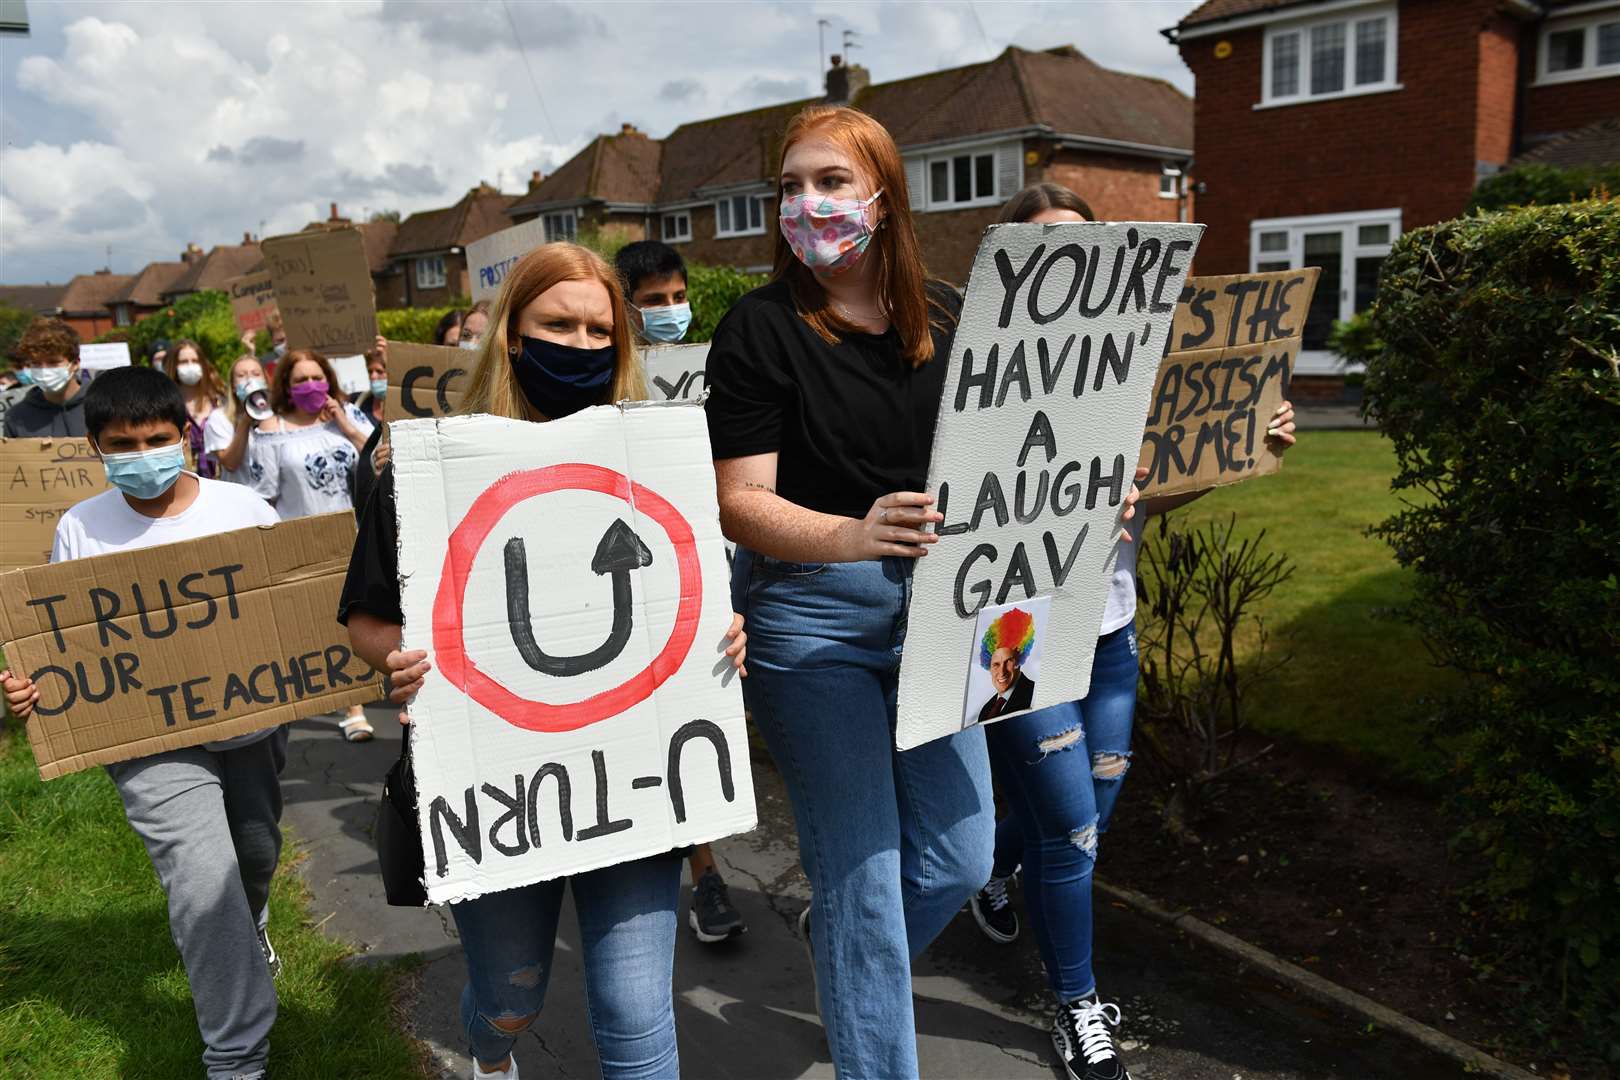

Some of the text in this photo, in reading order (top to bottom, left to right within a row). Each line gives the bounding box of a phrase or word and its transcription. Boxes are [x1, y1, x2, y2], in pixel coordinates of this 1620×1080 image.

[994, 228, 1193, 328] YOU'RE
[1224, 276, 1305, 346] THE
[954, 322, 1151, 412] HAVIN'
[1146, 351, 1293, 426] ASSISM
[9, 465, 93, 491] A FAIR
[1016, 410, 1057, 467] A
[1187, 407, 1256, 477] ME!
[934, 453, 1124, 536] LAUGH
[26, 564, 243, 653] TRUST
[953, 522, 1089, 619] GAV
[31, 652, 143, 716] OUR
[430, 719, 734, 877] U-TURN
